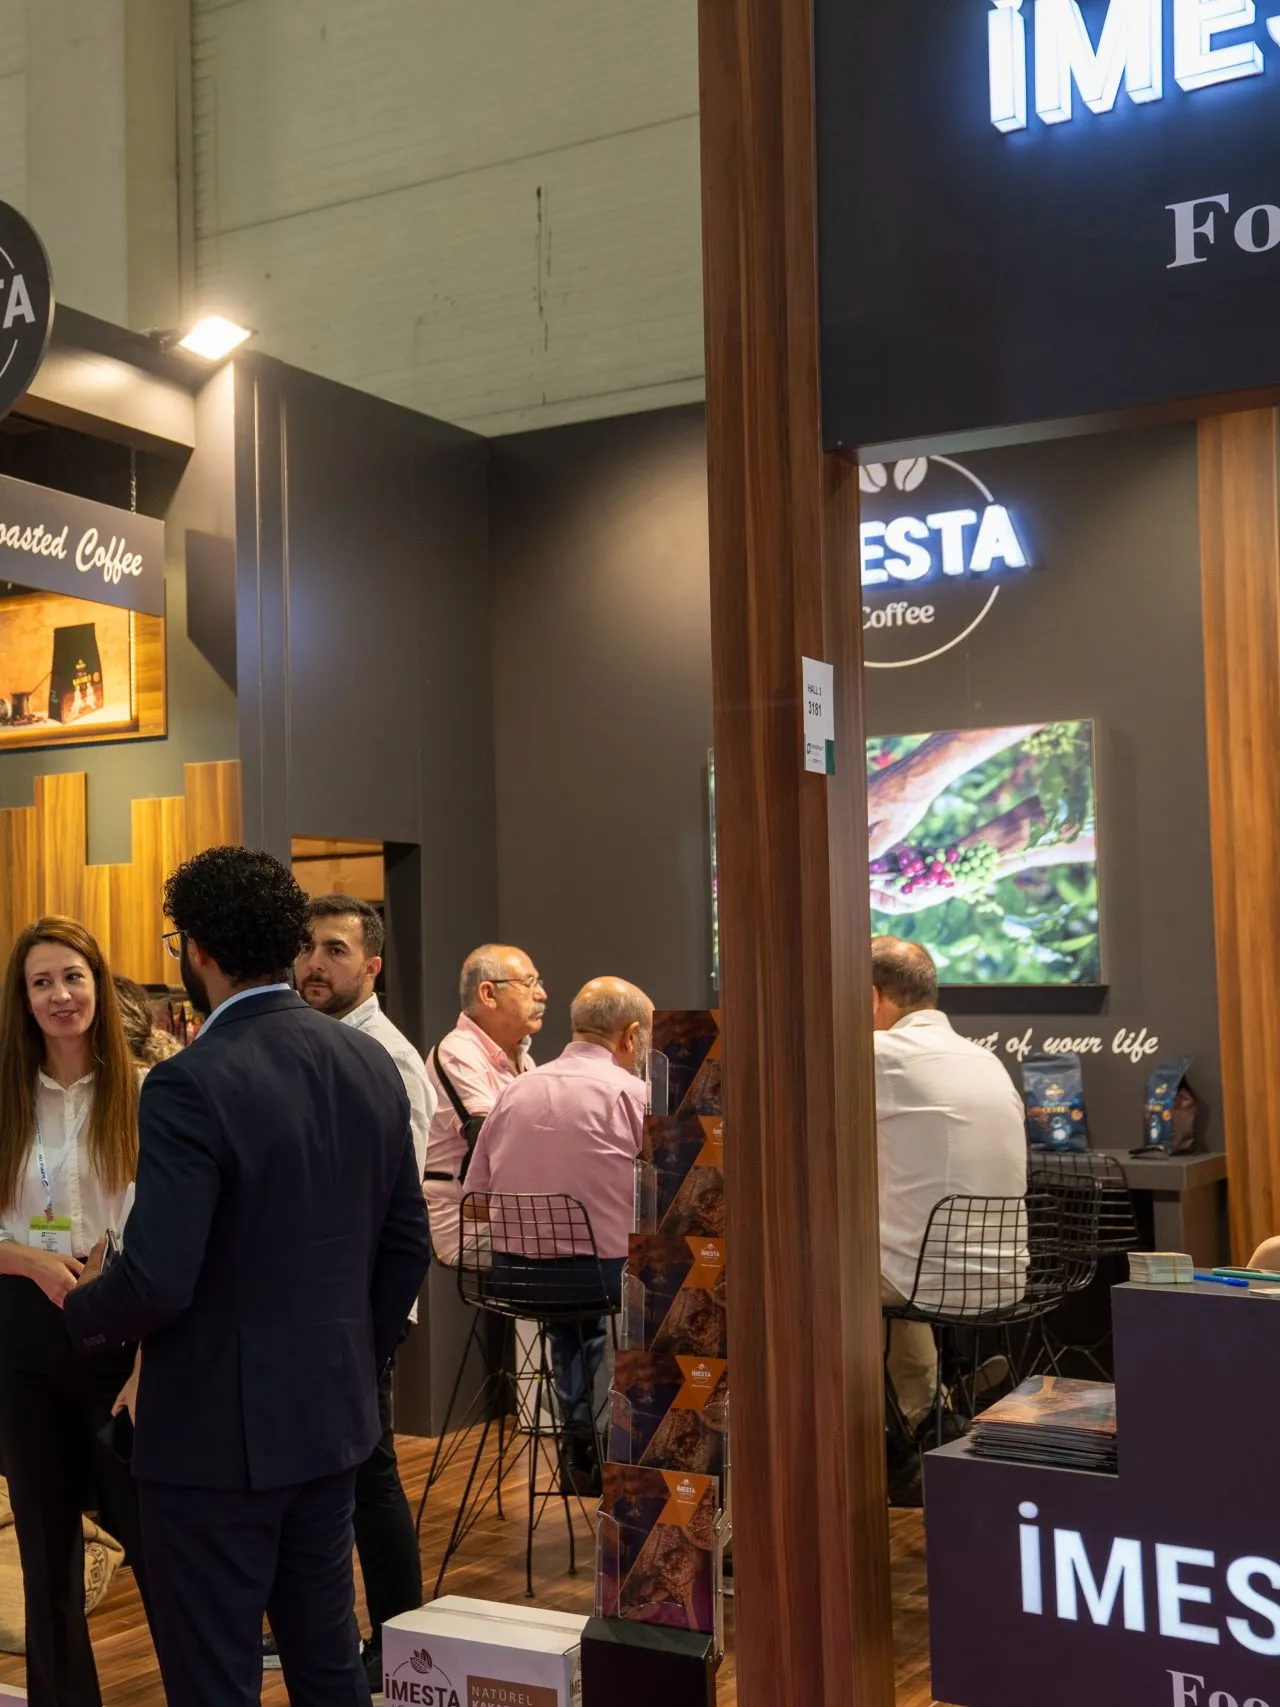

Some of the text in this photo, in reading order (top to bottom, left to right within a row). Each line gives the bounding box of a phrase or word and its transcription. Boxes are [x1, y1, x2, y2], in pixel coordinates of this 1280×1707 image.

[75, 528, 143, 584] Coffee
[860, 504, 1027, 586] ESTA
[808, 700, 822, 718] 3181
[1006, 1028, 1033, 1062] of
[1042, 1036, 1103, 1055] your
[1112, 1028, 1159, 1063] life
